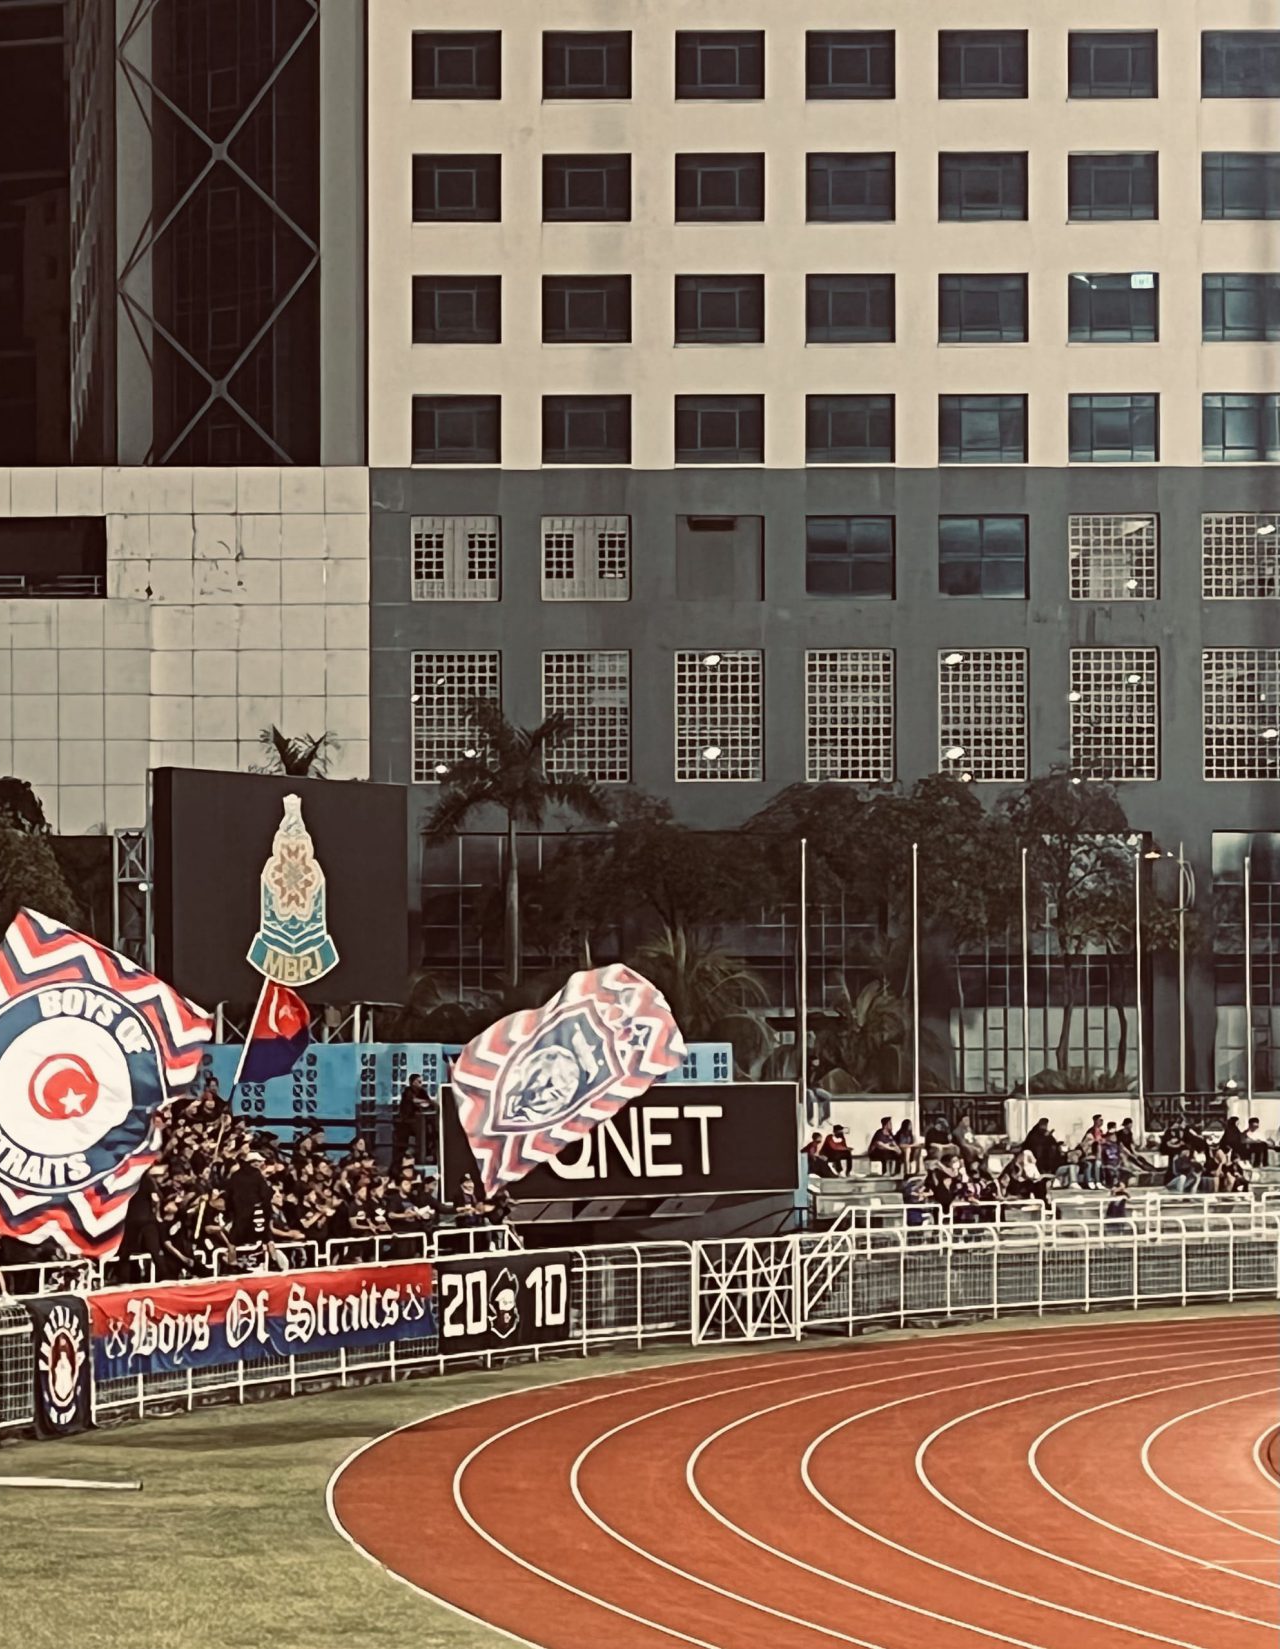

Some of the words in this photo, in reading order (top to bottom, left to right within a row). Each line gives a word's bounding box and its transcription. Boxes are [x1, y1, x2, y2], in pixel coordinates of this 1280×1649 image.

[263, 949, 323, 981] MBPJ
[38, 989, 121, 1025] BOYS
[116, 1017, 152, 1055] OF
[547, 1106, 723, 1180] QNET
[127, 1298, 212, 1366] Boys
[225, 1288, 270, 1348] Of
[284, 1280, 401, 1343] Straits
[442, 1270, 487, 1337] 20
[525, 1264, 567, 1327] 10
